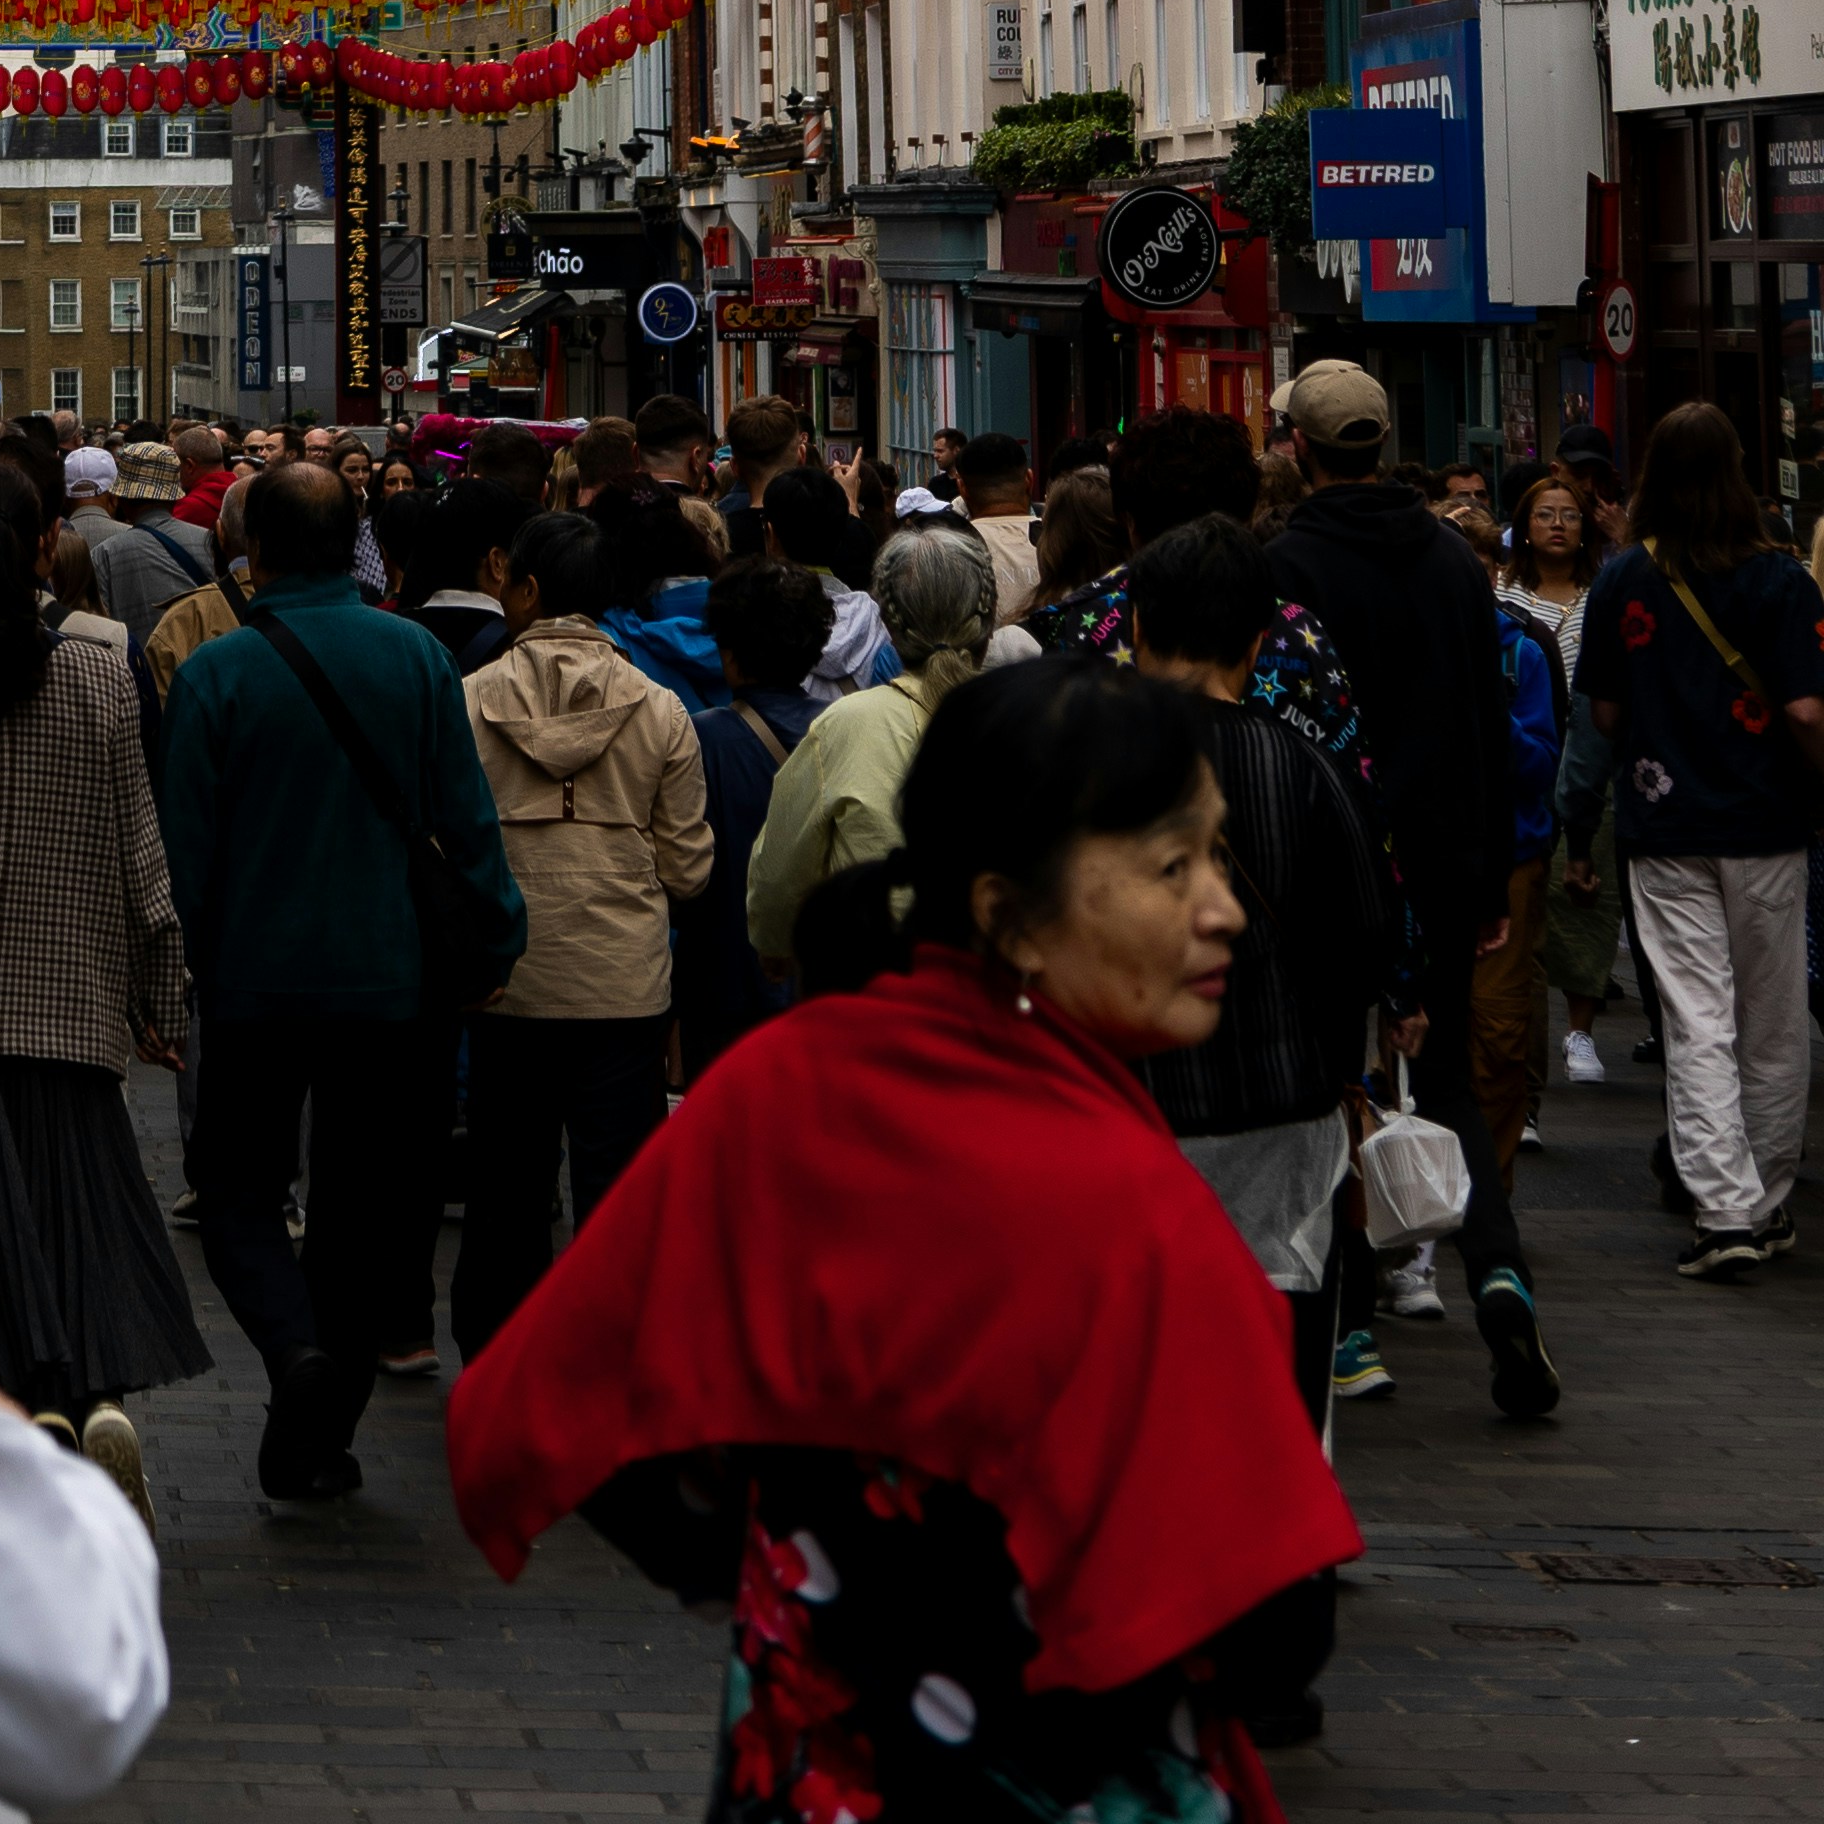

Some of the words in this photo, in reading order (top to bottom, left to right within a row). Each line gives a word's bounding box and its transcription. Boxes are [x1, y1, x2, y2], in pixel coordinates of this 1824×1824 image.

[1768, 140, 1787, 167] HOT
[1787, 139, 1811, 166] FOOD
[1321, 163, 1436, 185] BETFRED
[1122, 205, 1198, 288] O'Neill's
[538, 247, 584, 275] Chão
[1143, 285, 1164, 297] EAT
[1174, 271, 1202, 296] DRINK
[380, 307, 418, 319] ENDS
[388, 298, 408, 307] Zone
[244, 260, 262, 386] ODEON
[1607, 303, 1633, 338] 20
[723, 331, 757, 340] CHINESE
[387, 374, 405, 387] 20
[1090, 607, 1123, 647] JUICY
[1278, 703, 1327, 745] JUICY
